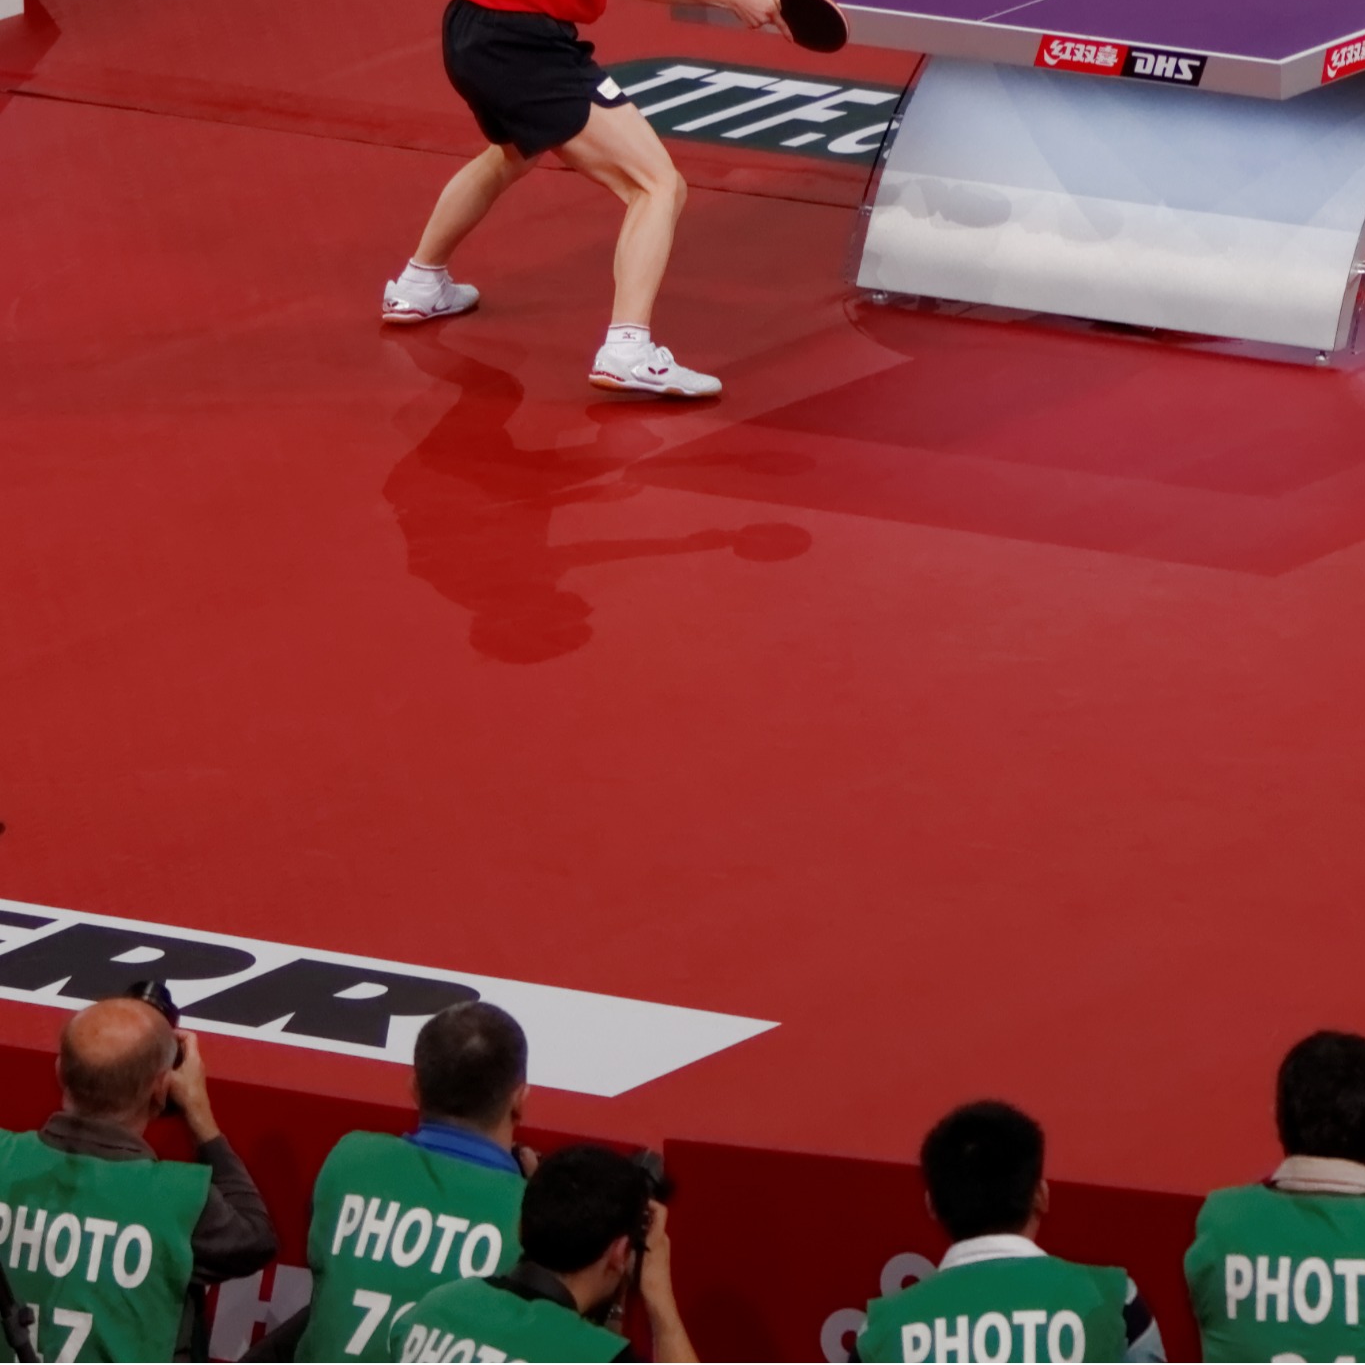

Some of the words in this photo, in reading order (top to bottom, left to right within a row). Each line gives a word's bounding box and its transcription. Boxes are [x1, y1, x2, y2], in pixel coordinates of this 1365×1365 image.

[1131, 50, 1201, 81] DHS
[0, 1202, 152, 1289] PHOTO
[331, 1194, 502, 1279] PHOTO
[344, 1288, 416, 1356] 7
[902, 1310, 1086, 1363] PHOTO
